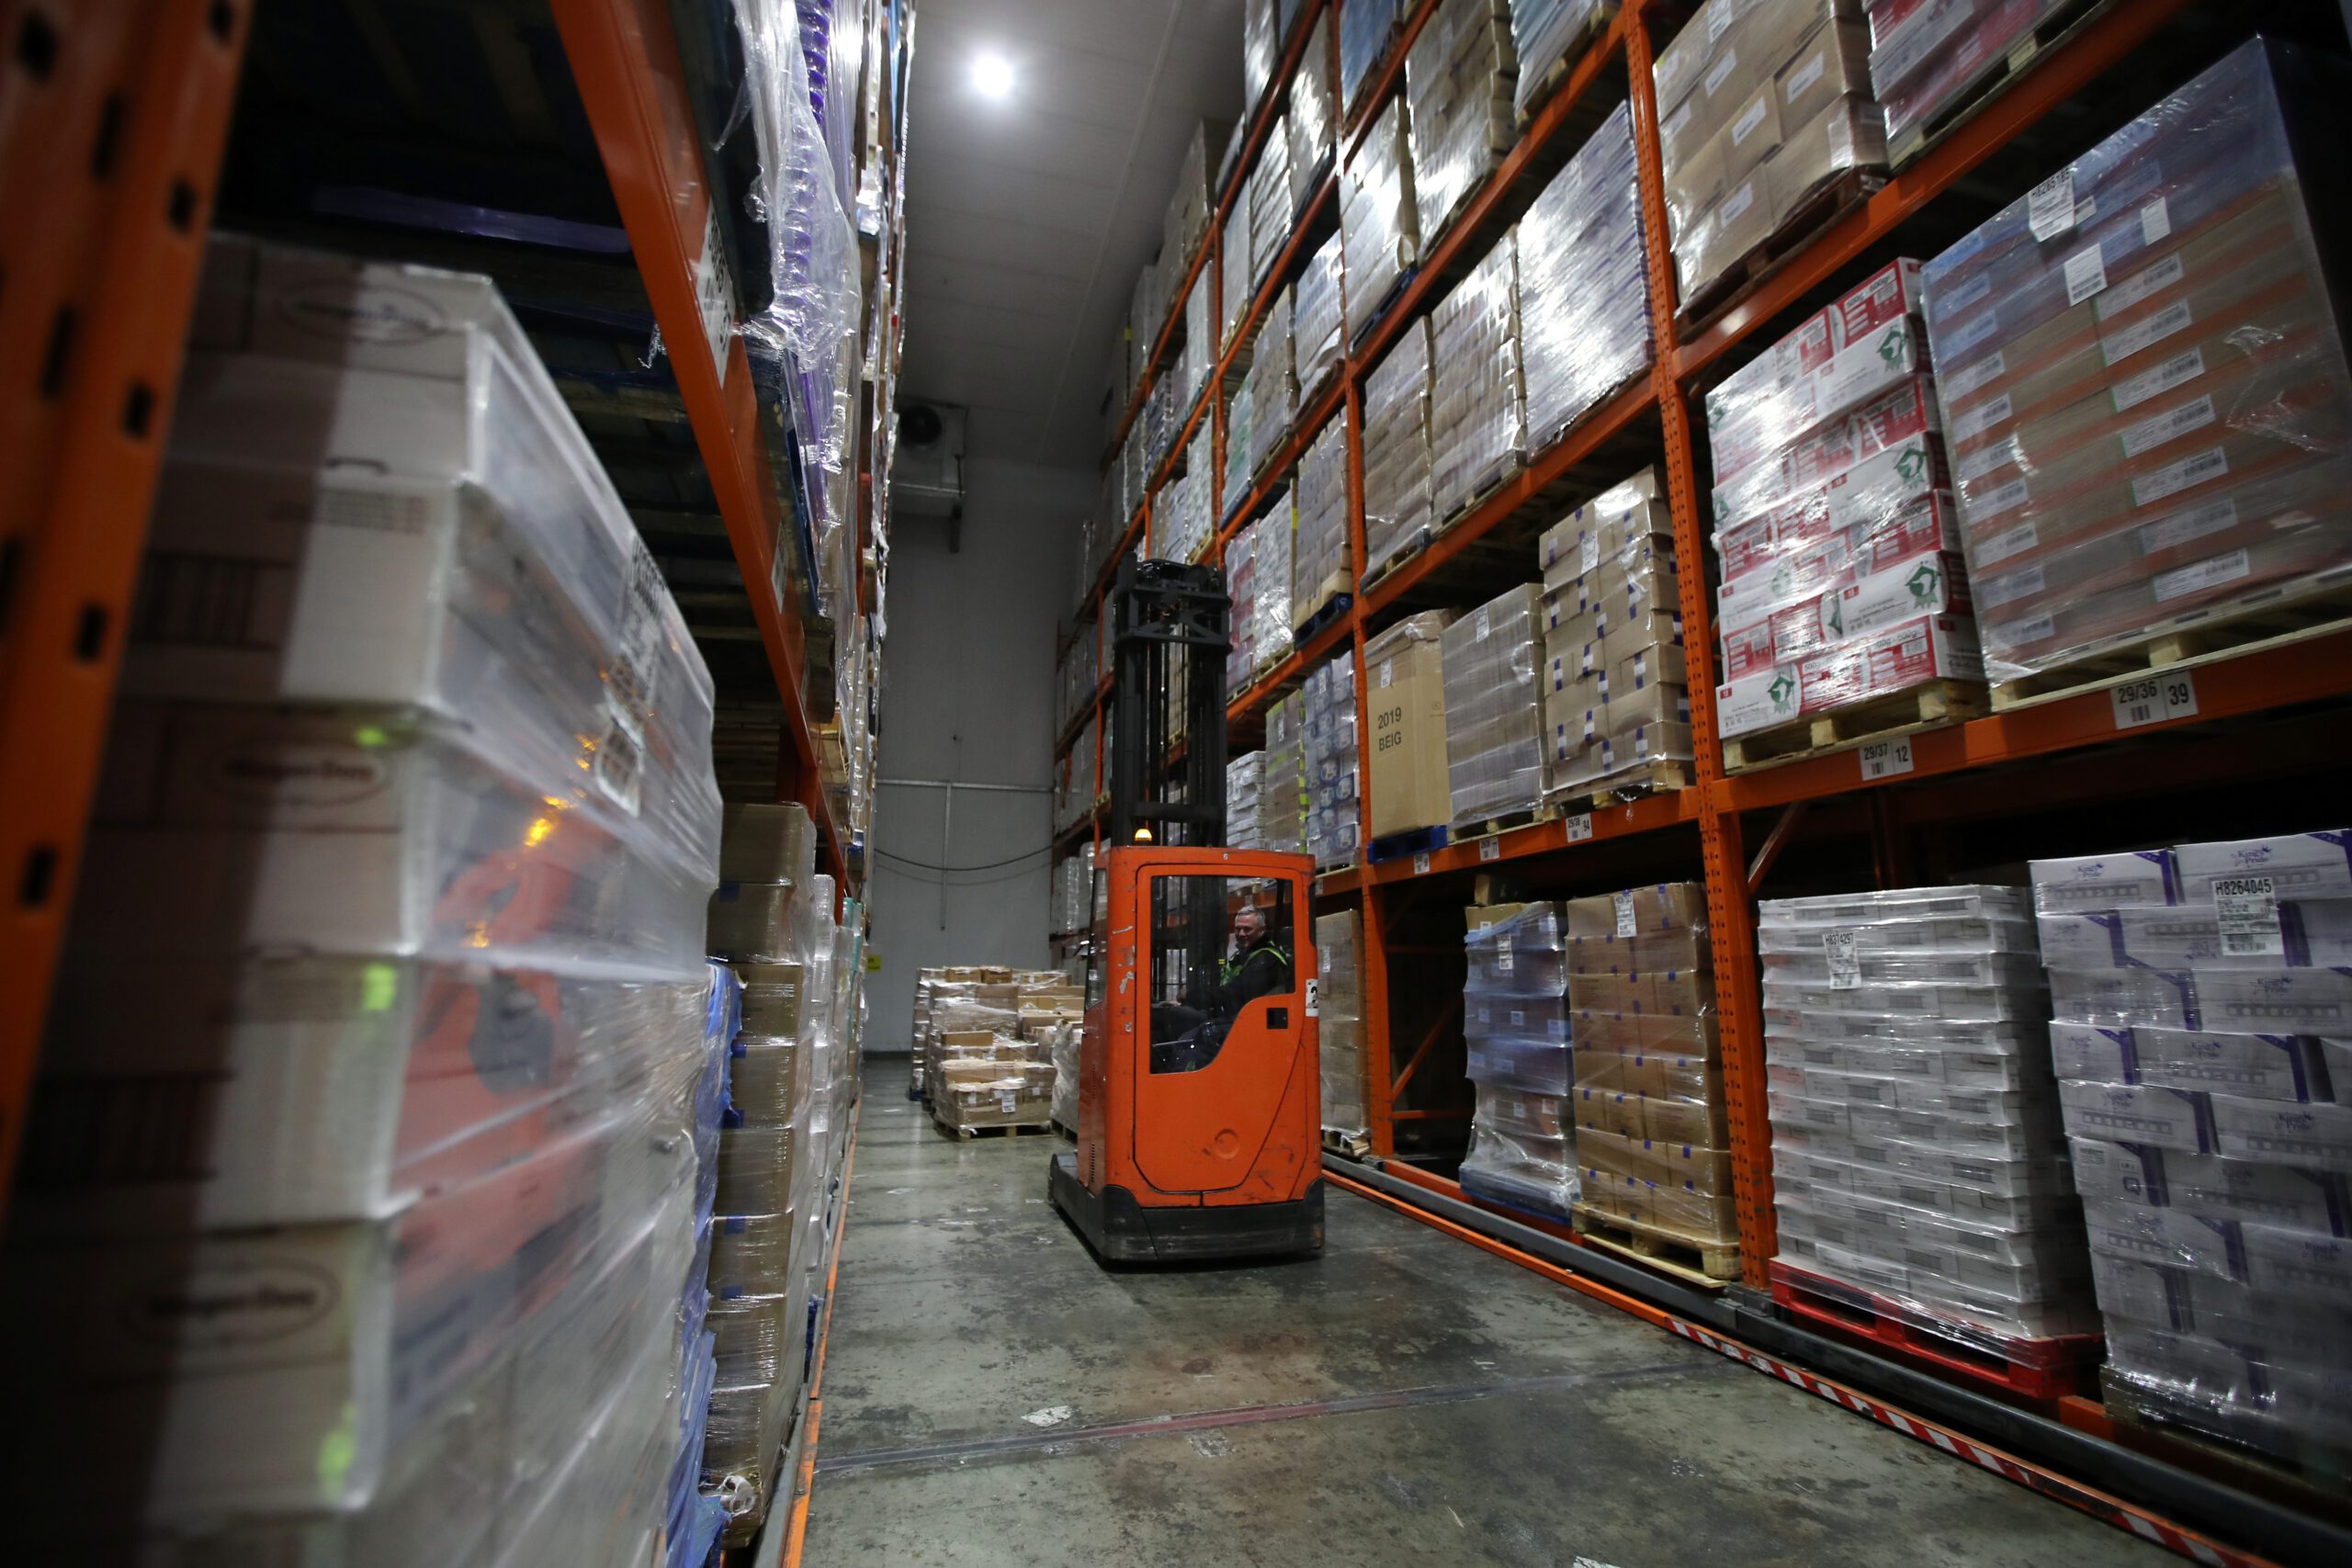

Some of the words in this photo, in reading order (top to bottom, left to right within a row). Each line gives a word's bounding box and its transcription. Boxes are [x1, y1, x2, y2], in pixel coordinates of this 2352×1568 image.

[2118, 678, 2158, 705] 29/36
[2167, 682, 2189, 705] 39
[1378, 706, 1402, 729] 2019
[1378, 731, 1402, 751] BEIG
[1863, 742, 1888, 761] 29/37
[1894, 745, 1909, 763] 12
[2215, 878, 2272, 897] H8264045
